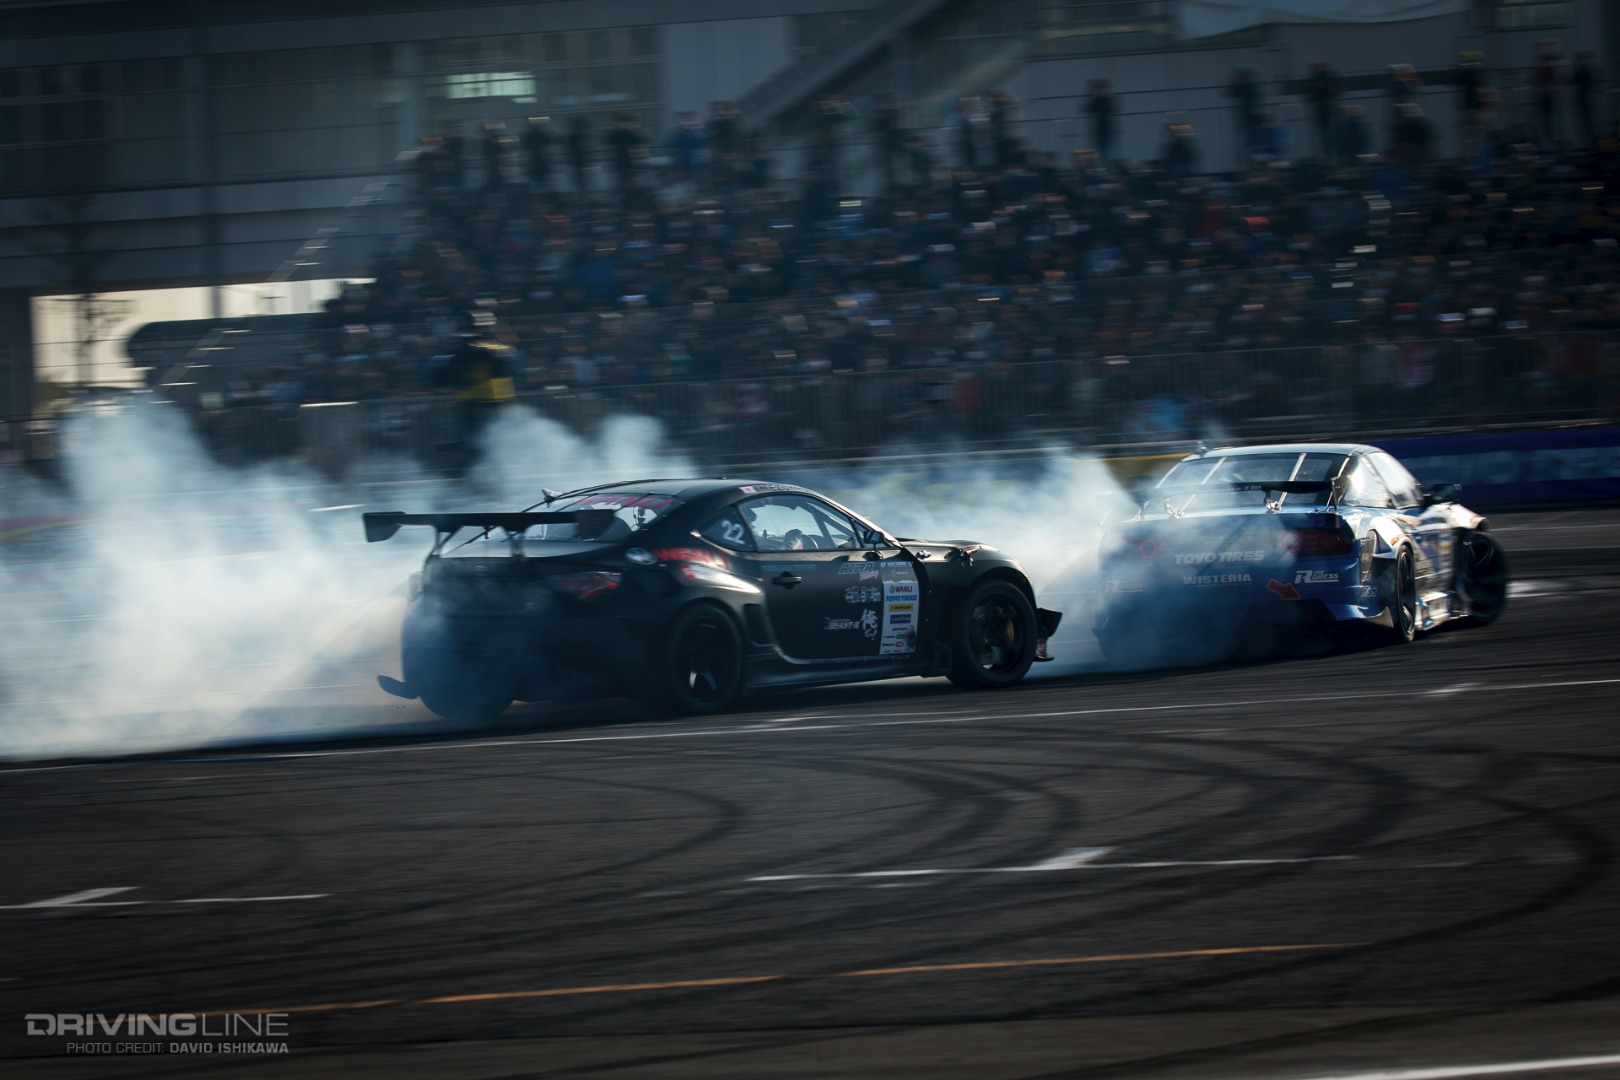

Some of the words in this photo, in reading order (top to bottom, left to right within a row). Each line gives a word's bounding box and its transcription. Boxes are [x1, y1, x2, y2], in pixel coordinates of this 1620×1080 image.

[721, 520, 745, 545] 22
[1174, 553, 1217, 565] TOYO
[1217, 550, 1265, 563] TIRES
[1183, 573, 1253, 585] WISTERIA
[895, 585, 913, 593] WANLI
[901, 594, 917, 602] TIRES
